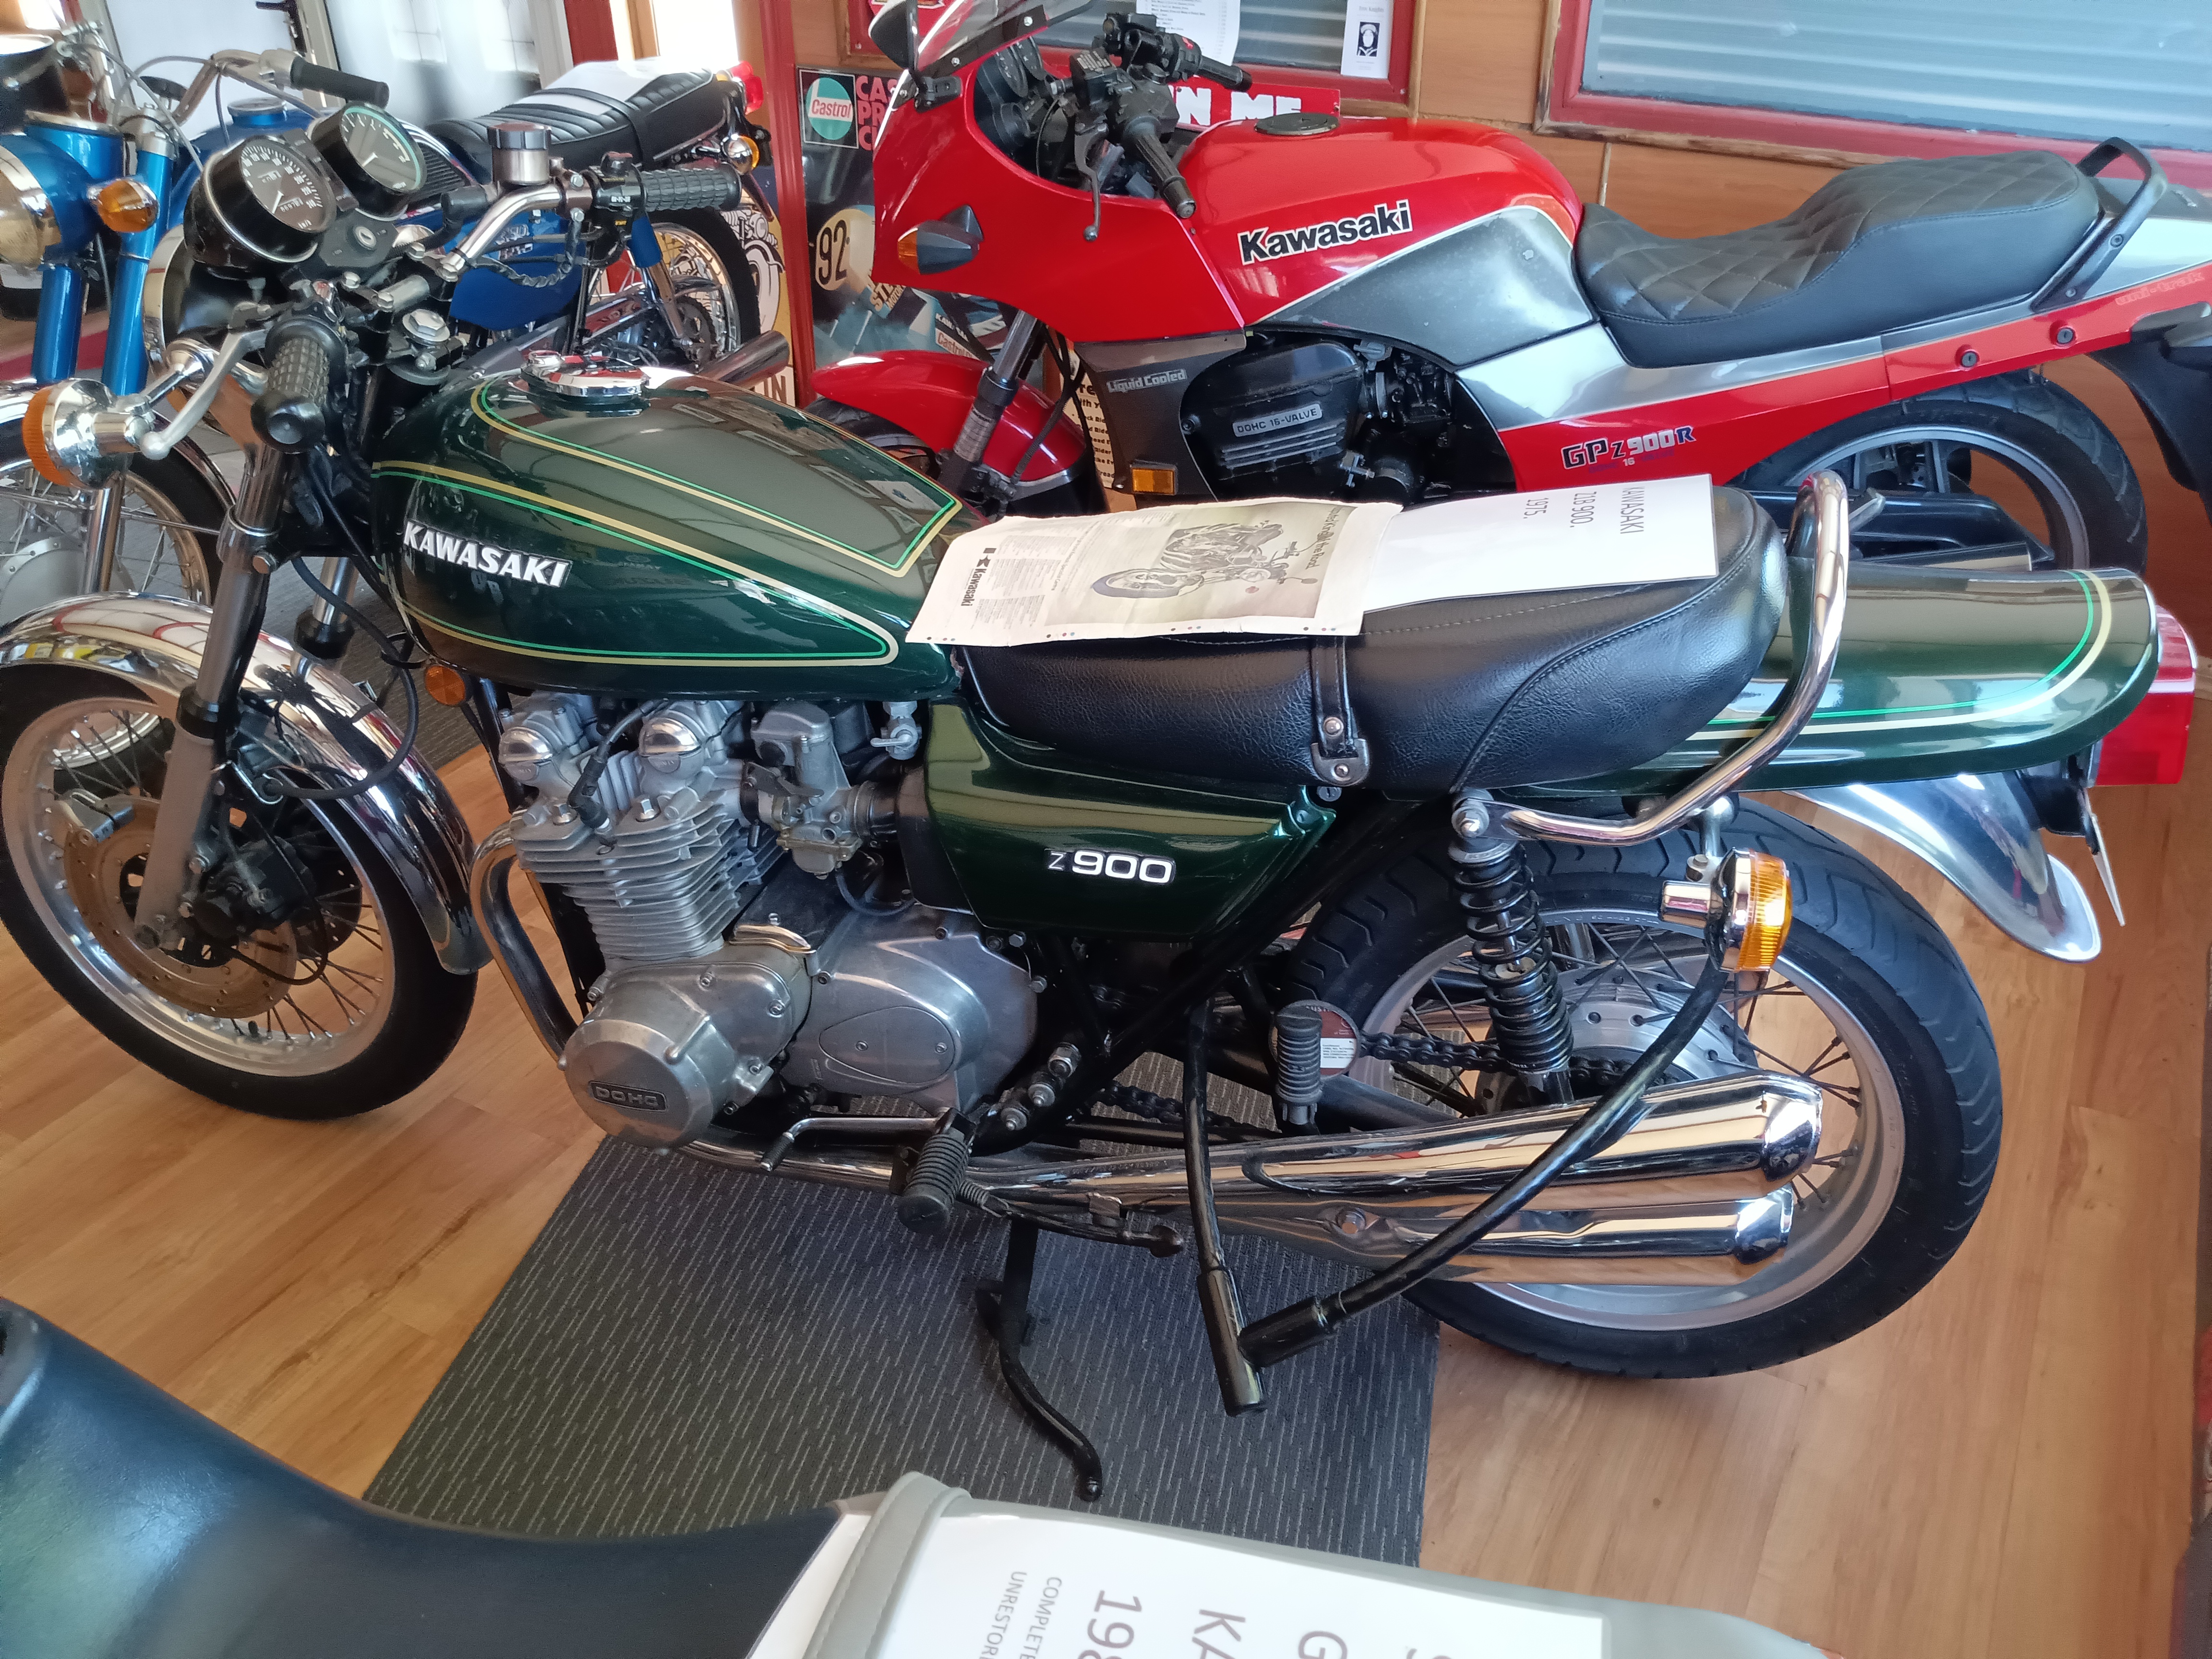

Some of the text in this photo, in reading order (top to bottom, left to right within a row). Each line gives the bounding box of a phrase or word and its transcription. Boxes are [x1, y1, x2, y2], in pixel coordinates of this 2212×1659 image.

[811, 99, 852, 119] Castrol
[1238, 198, 1413, 265] Kawasaki
[818, 219, 847, 285] 92
[1106, 368, 1188, 394] Liquid Cooled
[1237, 408, 1317, 433] DOHC 16-VALVE
[1523, 497, 1549, 519] 1975.
[1570, 505, 1595, 528] 900.
[1620, 486, 1645, 534] KAWASAKI
[404, 521, 570, 588] KAWASAKI
[960, 568, 987, 606] Kawasaki
[595, 1086, 659, 1107] DOHC
[979, 1571, 1027, 1659] UNRESTOR
